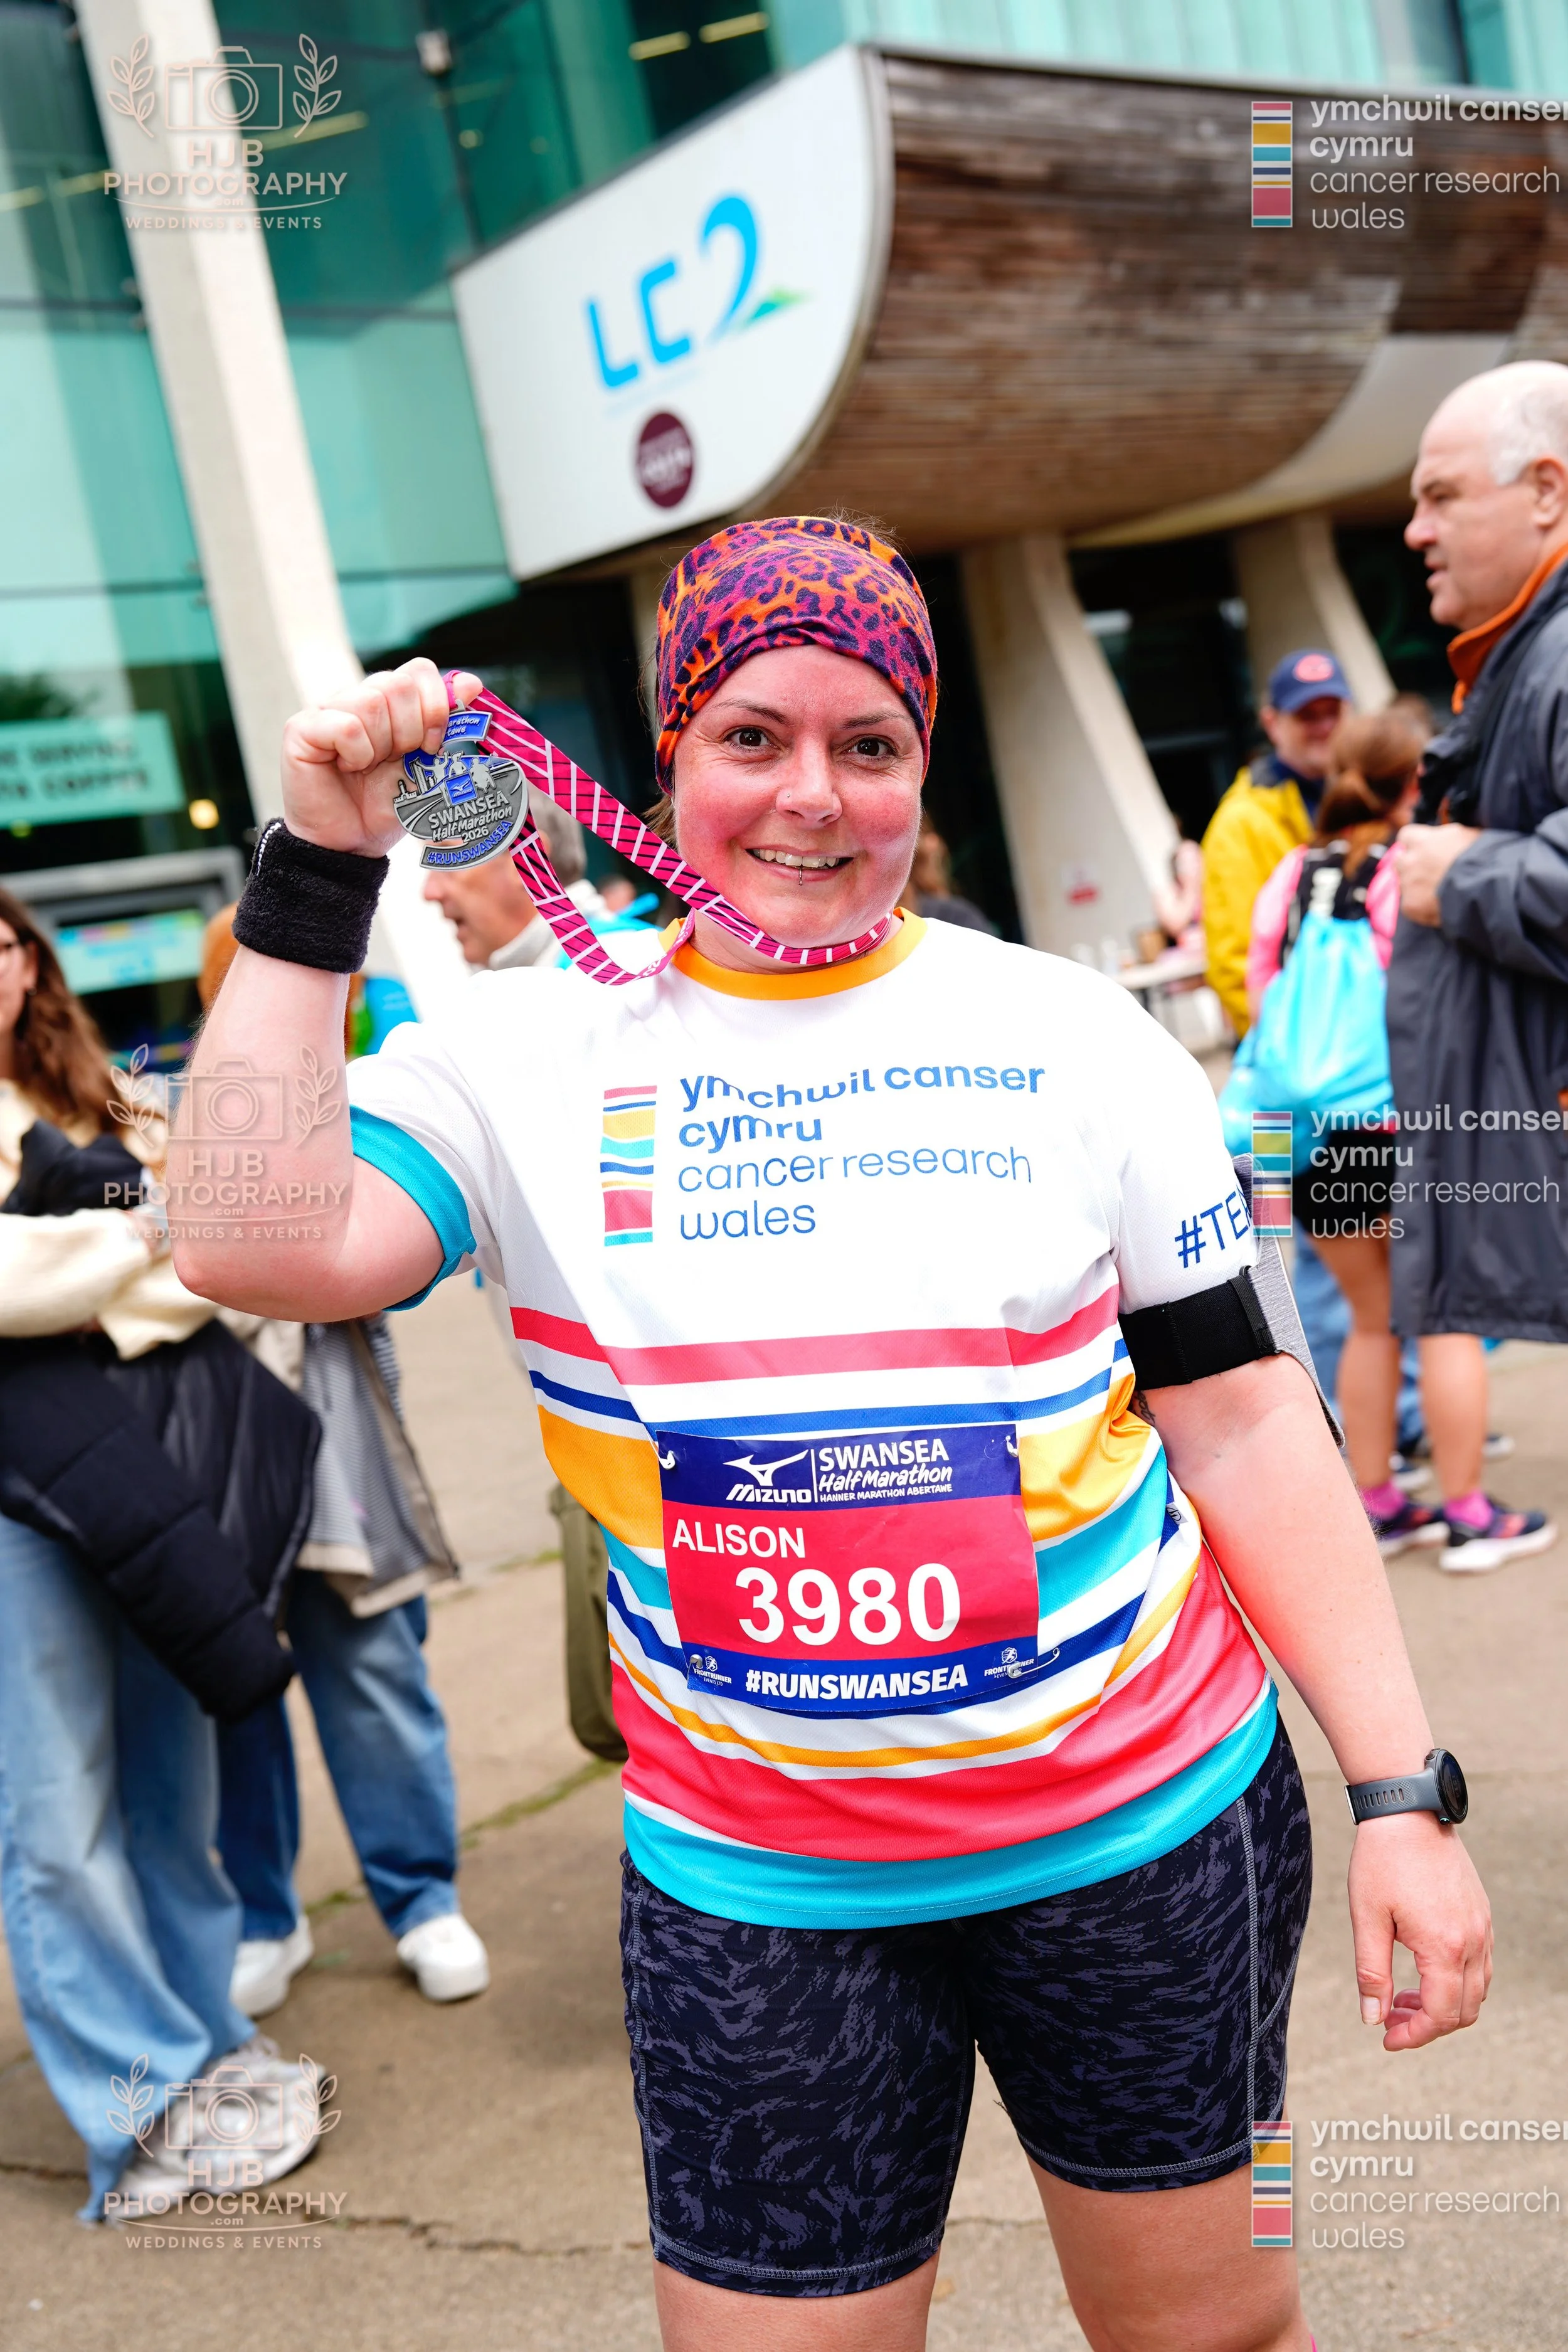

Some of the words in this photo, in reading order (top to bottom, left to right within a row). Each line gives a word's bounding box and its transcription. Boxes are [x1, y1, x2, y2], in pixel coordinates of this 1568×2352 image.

[448, 715, 480, 727] arathon
[428, 791, 509, 829] SWANSEA
[427, 820, 513, 865] #RUNSWANSEA
[462, 825, 489, 843] 2026
[680, 1068, 876, 1112] ymchwil
[884, 1066, 1046, 1093] canser
[679, 1113, 822, 1153] cymru
[678, 1155, 834, 1192] cancer
[844, 1147, 1032, 1184] research
[681, 1200, 816, 1240] wales
[818, 1438, 950, 1472] SWANSEA
[820, 1492, 856, 1502] HANNER
[857, 1488, 905, 1500] MARATHON
[907, 1483, 953, 1496] ABERTAWE
[672, 1518, 806, 1559] ALISON
[734, 1562, 961, 1646] 3980
[693, 1668, 732, 1684] FRONTRUNNER
[745, 1664, 968, 1700] #RUNSWANSEA
[984, 1658, 1034, 1677] FRONTNER
